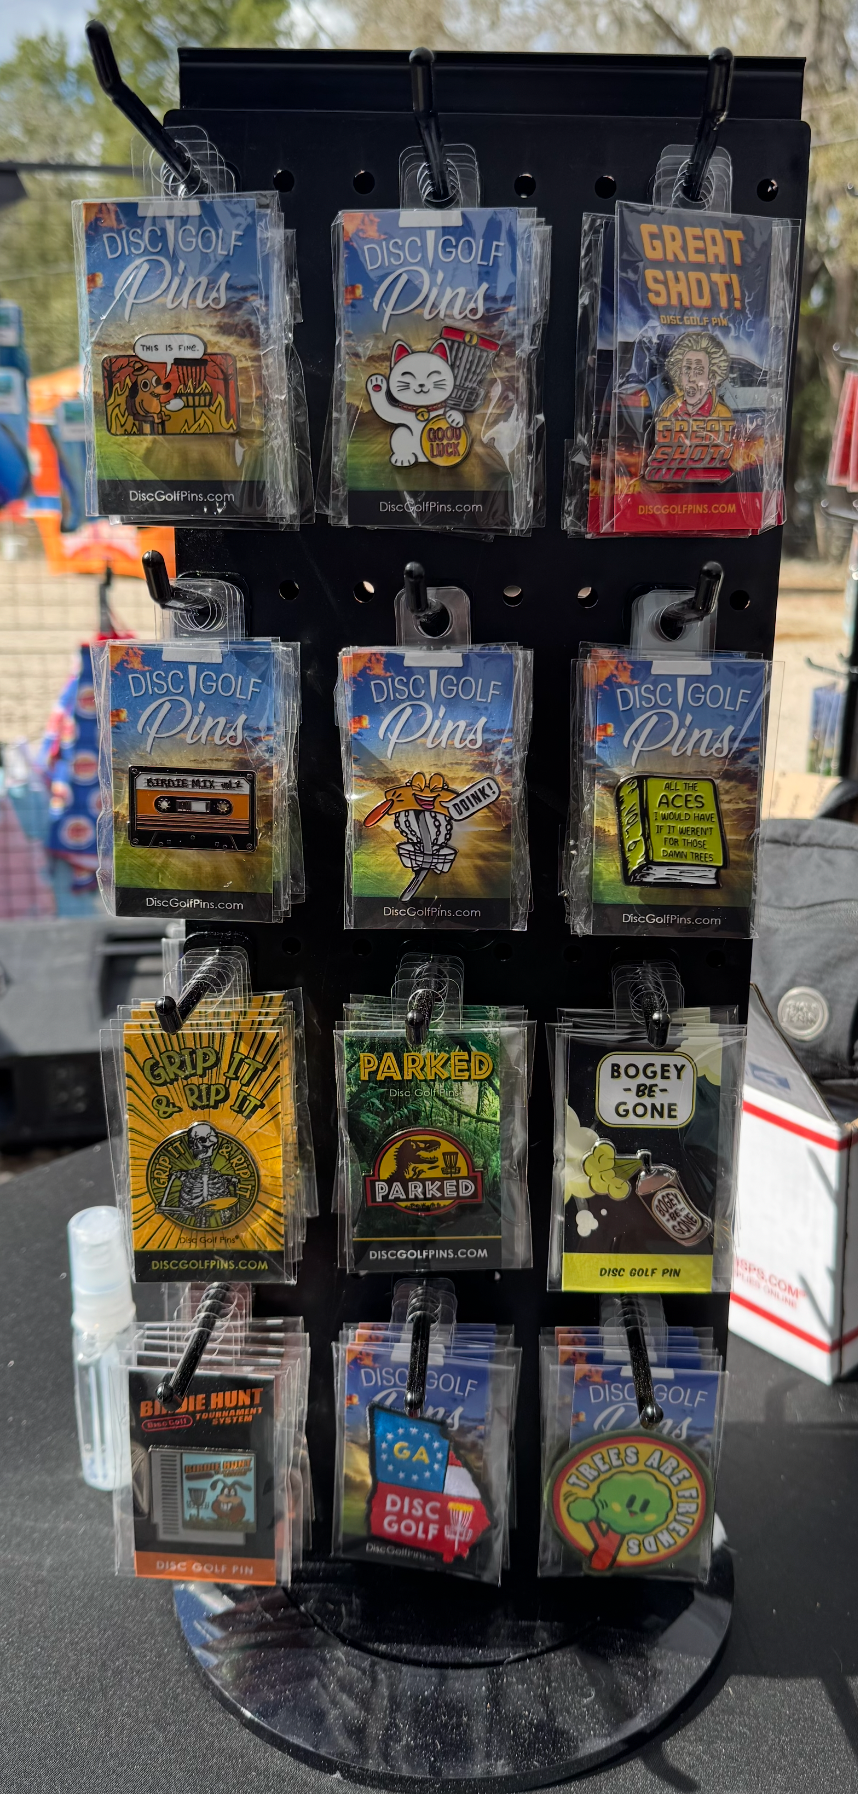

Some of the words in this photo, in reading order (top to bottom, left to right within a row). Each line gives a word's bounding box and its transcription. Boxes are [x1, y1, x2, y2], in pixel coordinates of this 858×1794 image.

[103, 227, 163, 259] DISC
[178, 226, 244, 256] GOLF
[364, 236, 422, 270] DISC
[438, 235, 505, 267] GOLF
[640, 223, 744, 267] GREAT
[114, 256, 231, 322] Pins
[644, 269, 742, 310] SHOT!
[373, 266, 490, 334] Pins
[660, 315, 681, 326] DISC
[683, 316, 709, 326] GOLF
[712, 317, 728, 327] PIN
[140, 344, 159, 352] THIS
[165, 344, 173, 352] IS
[427, 426, 462, 442] GOOD
[656, 419, 736, 443] GREAT
[430, 442, 460, 458] LUCK
[129, 490, 235, 503] DiscGolfPins.com
[379, 501, 483, 514] DiscGolfPins.com
[638, 503, 736, 516] DISCGOLFPINS.COM
[128, 670, 184, 697] DISC
[200, 671, 262, 700] GOLF
[370, 675, 425, 703] DISC
[440, 675, 502, 703] GOLF
[616, 683, 672, 712] DISC
[687, 683, 752, 711] GOLF
[137, 696, 247, 755] Pins
[378, 701, 488, 760] Pins
[622, 709, 735, 767] Pins
[146, 777, 188, 788] BIRDIE
[191, 779, 215, 789] MIX
[664, 782, 680, 791] ALL
[683, 782, 698, 791] THE
[452, 782, 496, 816] DOINK!
[657, 794, 705, 809] ACES
[653, 812, 658, 820] I
[661, 812, 691, 821] WOULD
[693, 812, 715, 822] HAVE
[655, 825, 664, 834] IF
[667, 825, 675, 834] IT
[678, 826, 713, 836] WEREN'T
[663, 837, 679, 846] FOR
[683, 838, 707, 849] THOSE
[661, 849, 688, 859] DAMN
[690, 851, 714, 862] TREES
[146, 898, 244, 911] DiscGolfPins.com
[383, 907, 481, 918] DiscGolfPins.com
[622, 913, 721, 926] DiscGolfPins.com
[142, 1046, 220, 1087] GRIP
[223, 1051, 268, 1087] IT
[359, 1051, 494, 1081] PARKED
[610, 1063, 687, 1081] BOGEY
[152, 1094, 183, 1119] &
[185, 1083, 230, 1110] RIP
[230, 1090, 265, 1120] IT
[389, 1088, 411, 1097] Disc
[414, 1088, 436, 1097] Golf
[614, 1102, 679, 1120] GONE
[168, 1141, 185, 1158] IT
[218, 1143, 232, 1159] &
[153, 1155, 172, 1188] GRIP
[230, 1155, 251, 1179] RIP
[236, 1183, 253, 1199] IT
[374, 1178, 476, 1202] PARKED
[655, 1192, 681, 1217] BOGEY
[671, 1212, 697, 1235] GONE
[179, 1235, 197, 1244] Disc
[200, 1236, 217, 1244] Golf
[369, 1248, 488, 1260] DISCGOLFPINS.COM
[151, 1259, 269, 1271] DISCGOLFPINS.COM
[599, 1267, 626, 1278] DISC
[629, 1267, 658, 1278] GOLF
[661, 1268, 681, 1278] PIN
[425, 1370, 478, 1397] GOLF
[210, 1388, 264, 1410] HUNT
[653, 1384, 708, 1408] GOLF
[195, 1407, 263, 1420] TOURNAMENT
[212, 1414, 253, 1425] SYSTEM
[393, 1441, 430, 1464] GA
[184, 1462, 220, 1474] BIRDIE
[223, 1458, 252, 1469] HUNT
[568, 1446, 640, 1490] TREES
[644, 1449, 691, 1487] ARE
[385, 1494, 441, 1520] DISC
[383, 1515, 439, 1541] GOLF
[627, 1487, 699, 1556] FRIENDS
[156, 1560, 187, 1572] DISC
[192, 1562, 227, 1574] GOLF
[232, 1565, 254, 1575] PIN
